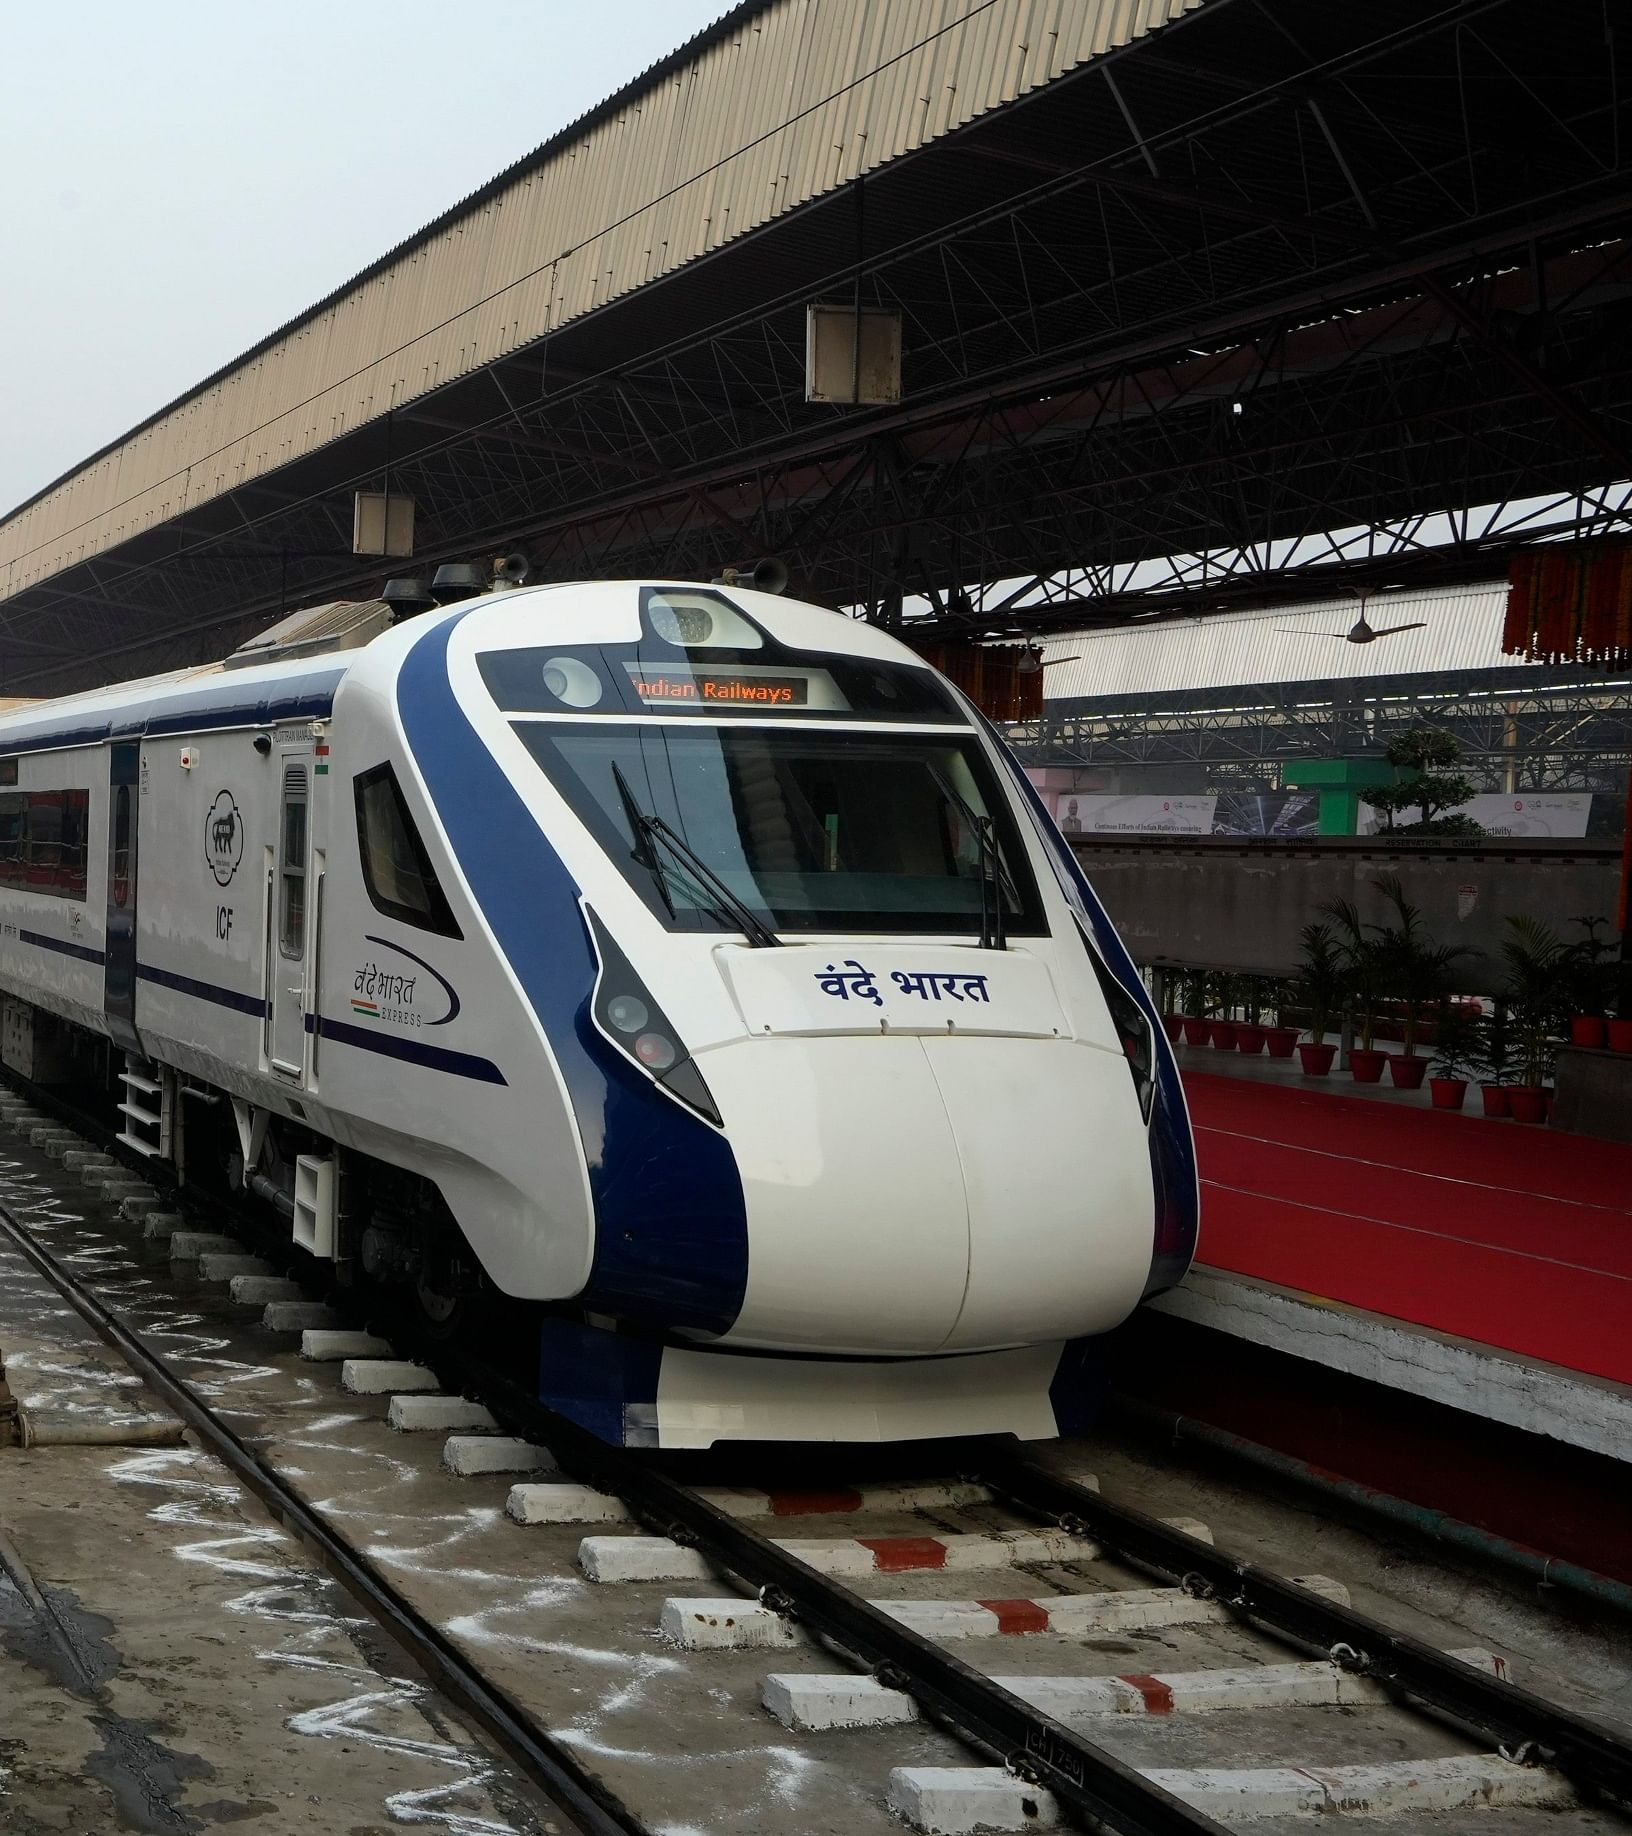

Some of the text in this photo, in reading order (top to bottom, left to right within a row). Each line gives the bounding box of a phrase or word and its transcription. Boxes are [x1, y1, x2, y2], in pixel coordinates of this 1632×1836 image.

[703, 681, 793, 704] Railways
[1158, 824, 1179, 832] Railways
[1385, 839, 1481, 848] RESERVATION CHART
[216, 905, 234, 941] ICF
[354, 962, 417, 1005] वंदे भारत
[814, 960, 990, 1007] वंदे भारत
[381, 1007, 422, 1028] EXPRESS
